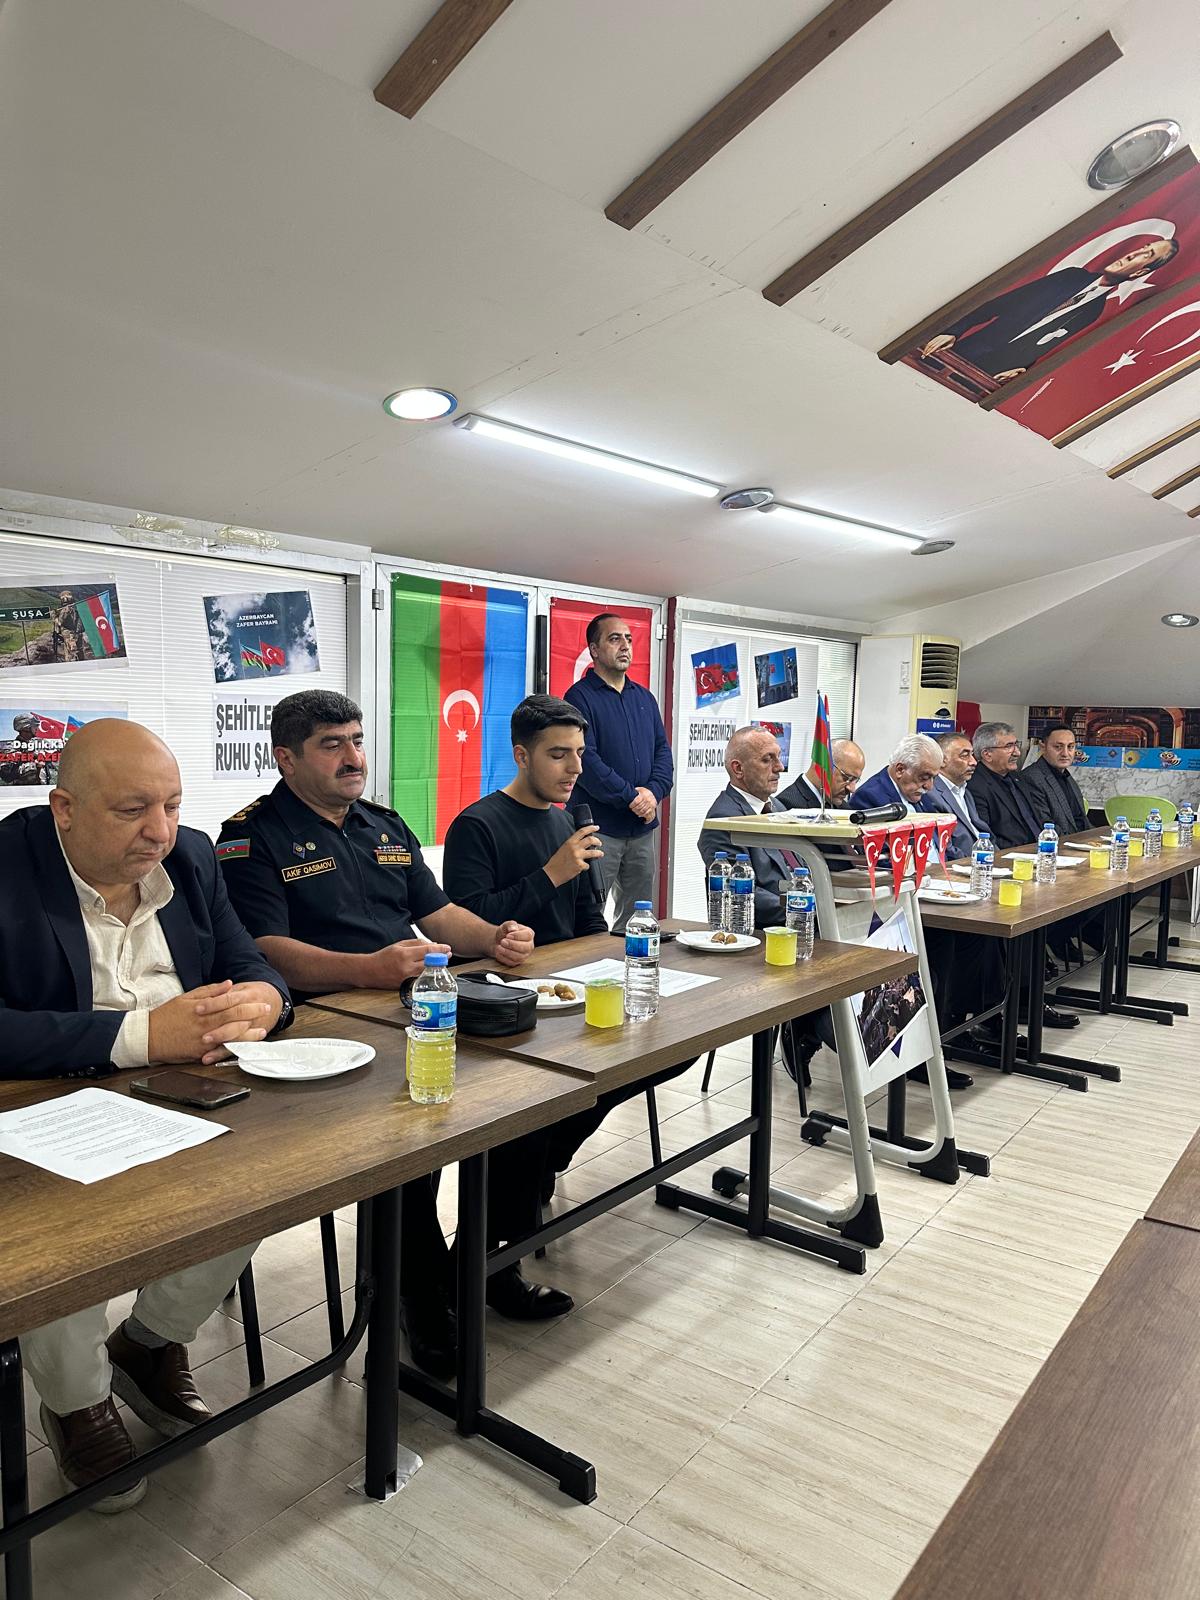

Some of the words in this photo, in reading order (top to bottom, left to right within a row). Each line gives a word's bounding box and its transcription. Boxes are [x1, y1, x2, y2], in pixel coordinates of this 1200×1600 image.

[12, 609, 44, 620] ŞUŞA
[238, 613, 275, 621] AZERBAYCAN
[216, 697, 274, 738] ŞEHİTLE
[13, 740, 50, 751] Dağlık
[51, 740, 65, 749] Ka
[37, 752, 60, 762] AZE
[215, 742, 251, 771] RUHU
[688, 748, 704, 768] RUHU
[704, 748, 716, 772] ŞAD
